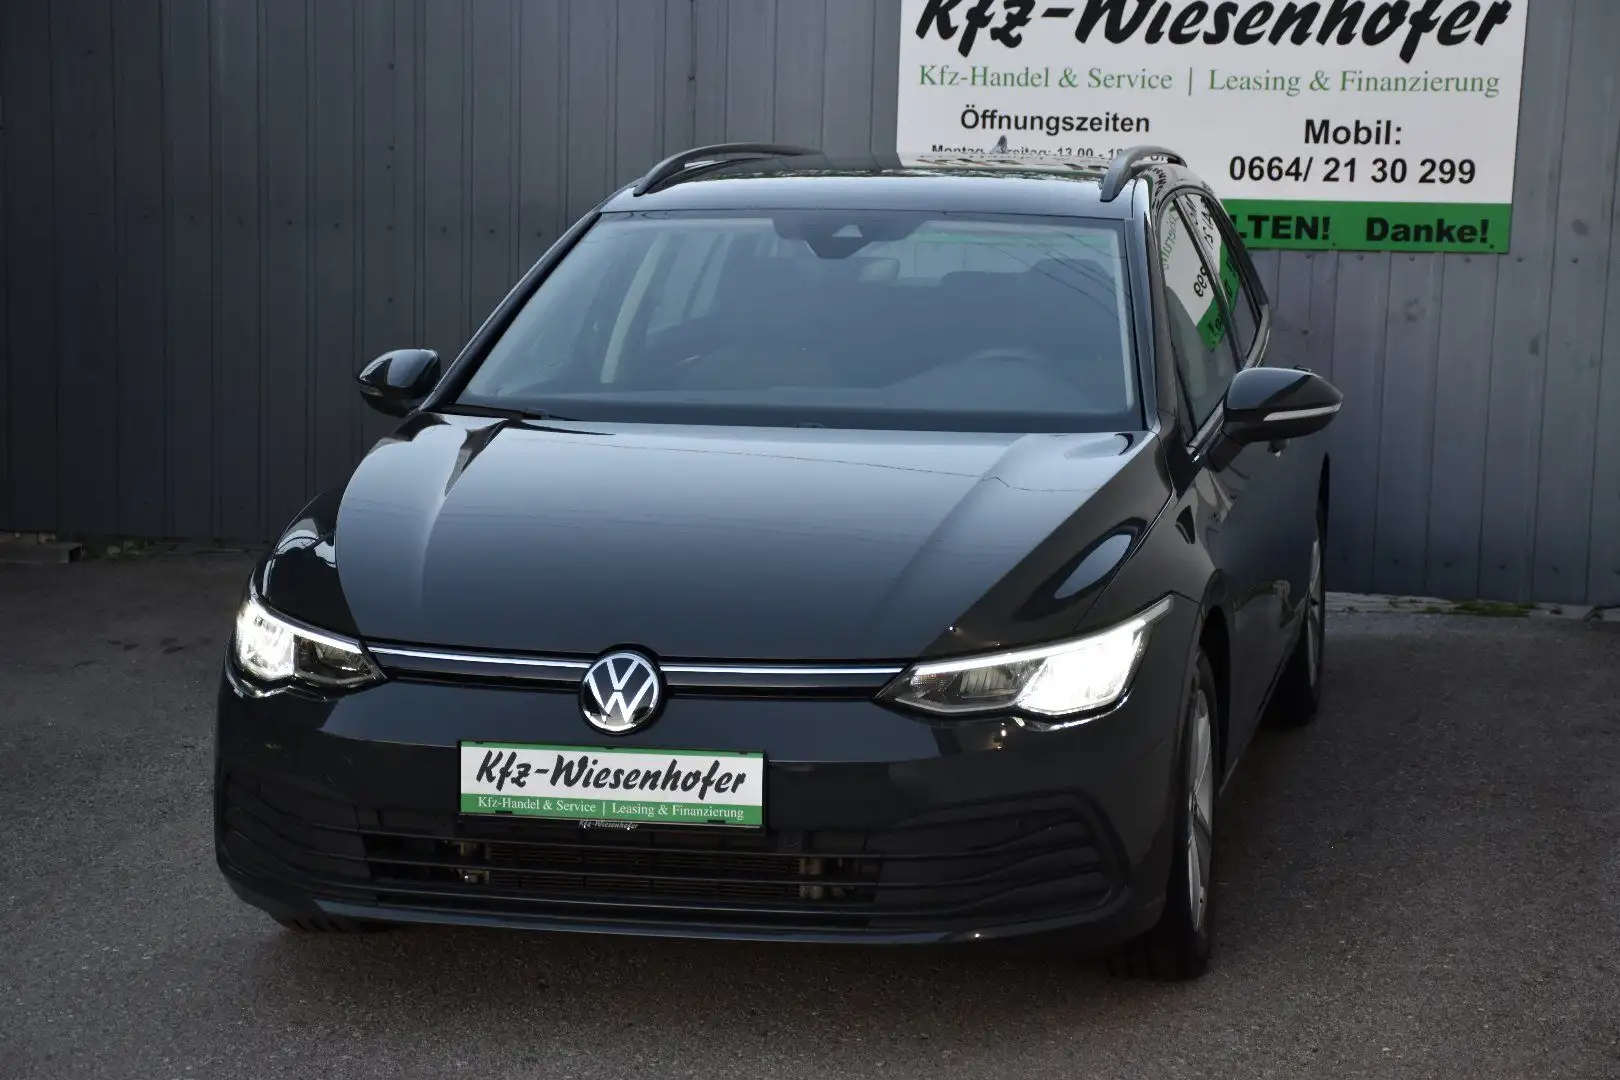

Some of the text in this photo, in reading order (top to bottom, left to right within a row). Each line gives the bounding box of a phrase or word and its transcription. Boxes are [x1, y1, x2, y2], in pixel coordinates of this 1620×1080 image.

[919, 64, 1049, 88] Kfz-Handel
[1058, 68, 1079, 89] &
[1088, 67, 1173, 89] Service
[1209, 69, 1301, 96] Leasing
[1309, 70, 1330, 91] &
[1340, 70, 1500, 98] Finanzierung
[960, 104, 1150, 136] Öffnungszeiten
[1304, 118, 1402, 145] Mobil:
[1229, 155, 1476, 184] 0664/ 21 30 299
[1366, 216, 1490, 243] Danke!
[475, 750, 747, 800] Kfz-Wiesenhofer
[478, 796, 540, 810] Kfz-Handel
[543, 800, 553, 811] &
[556, 800, 597, 812] Service
[612, 802, 655, 817] Leasing
[658, 804, 669, 815] &
[672, 804, 745, 820] Finanzierung
